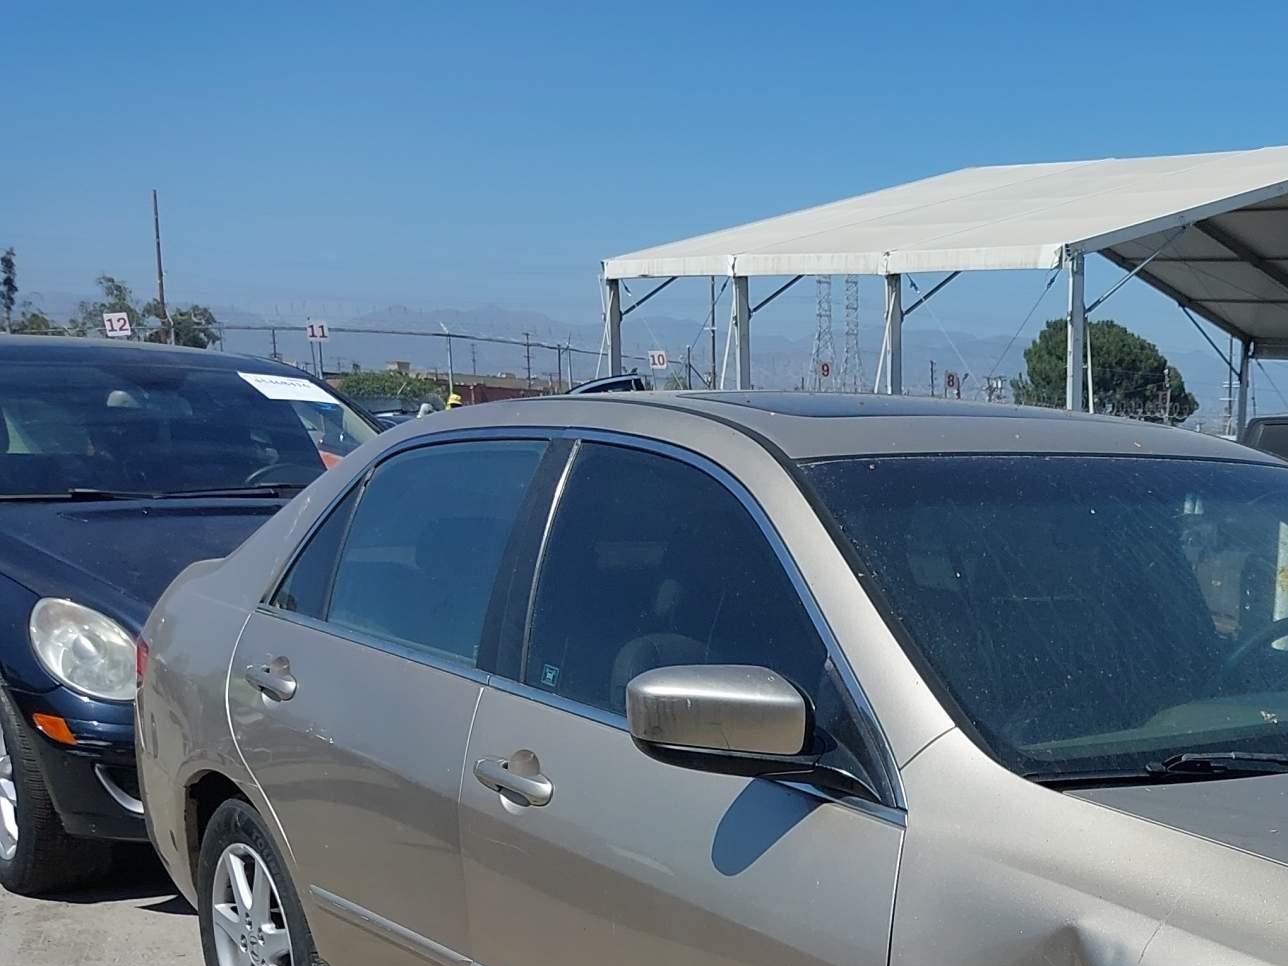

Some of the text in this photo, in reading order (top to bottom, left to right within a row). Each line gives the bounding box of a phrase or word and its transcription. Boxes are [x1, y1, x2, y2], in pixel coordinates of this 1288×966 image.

[105, 317, 129, 333] 12
[308, 324, 329, 338] 11
[650, 354, 666, 366] 10
[822, 363, 829, 377] 9
[947, 374, 955, 388] 8
